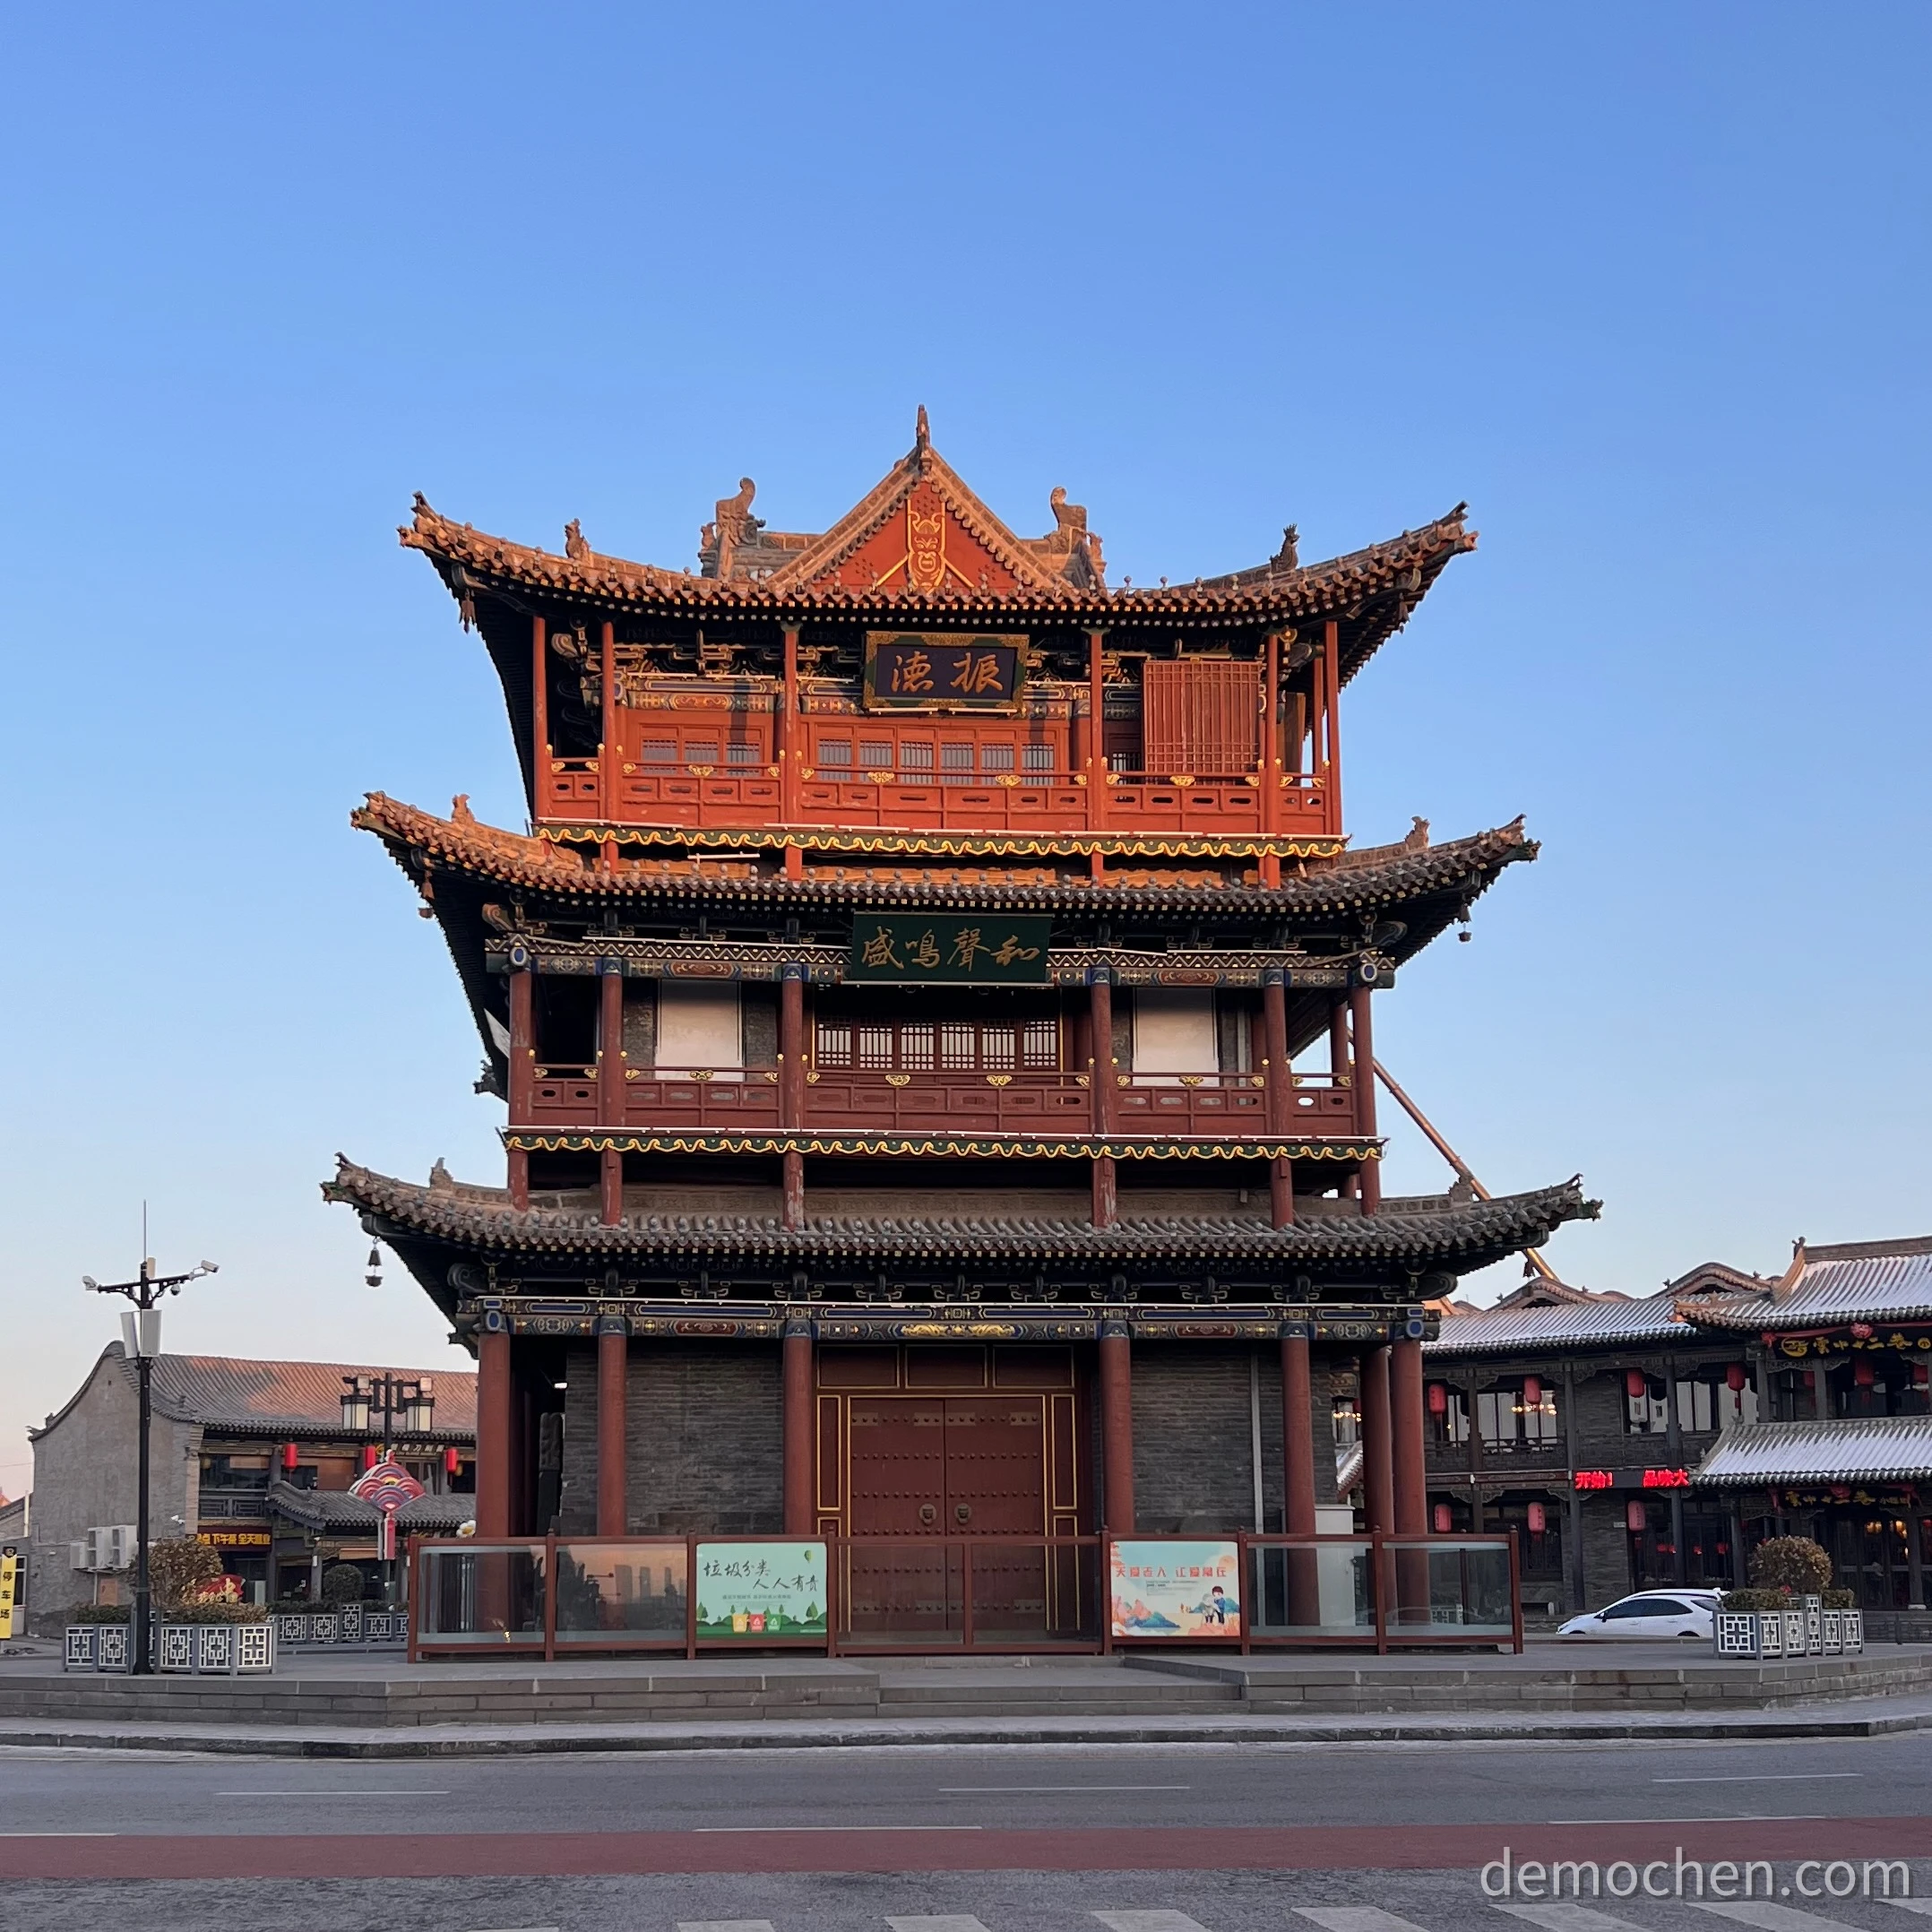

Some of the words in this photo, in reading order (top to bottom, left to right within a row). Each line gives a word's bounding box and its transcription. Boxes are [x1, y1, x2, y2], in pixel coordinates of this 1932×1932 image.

[703, 1558, 772, 1578] 垃圾分类
[752, 1574, 820, 1592] 人人有责
[0, 1571, 13, 1619] 停车场
